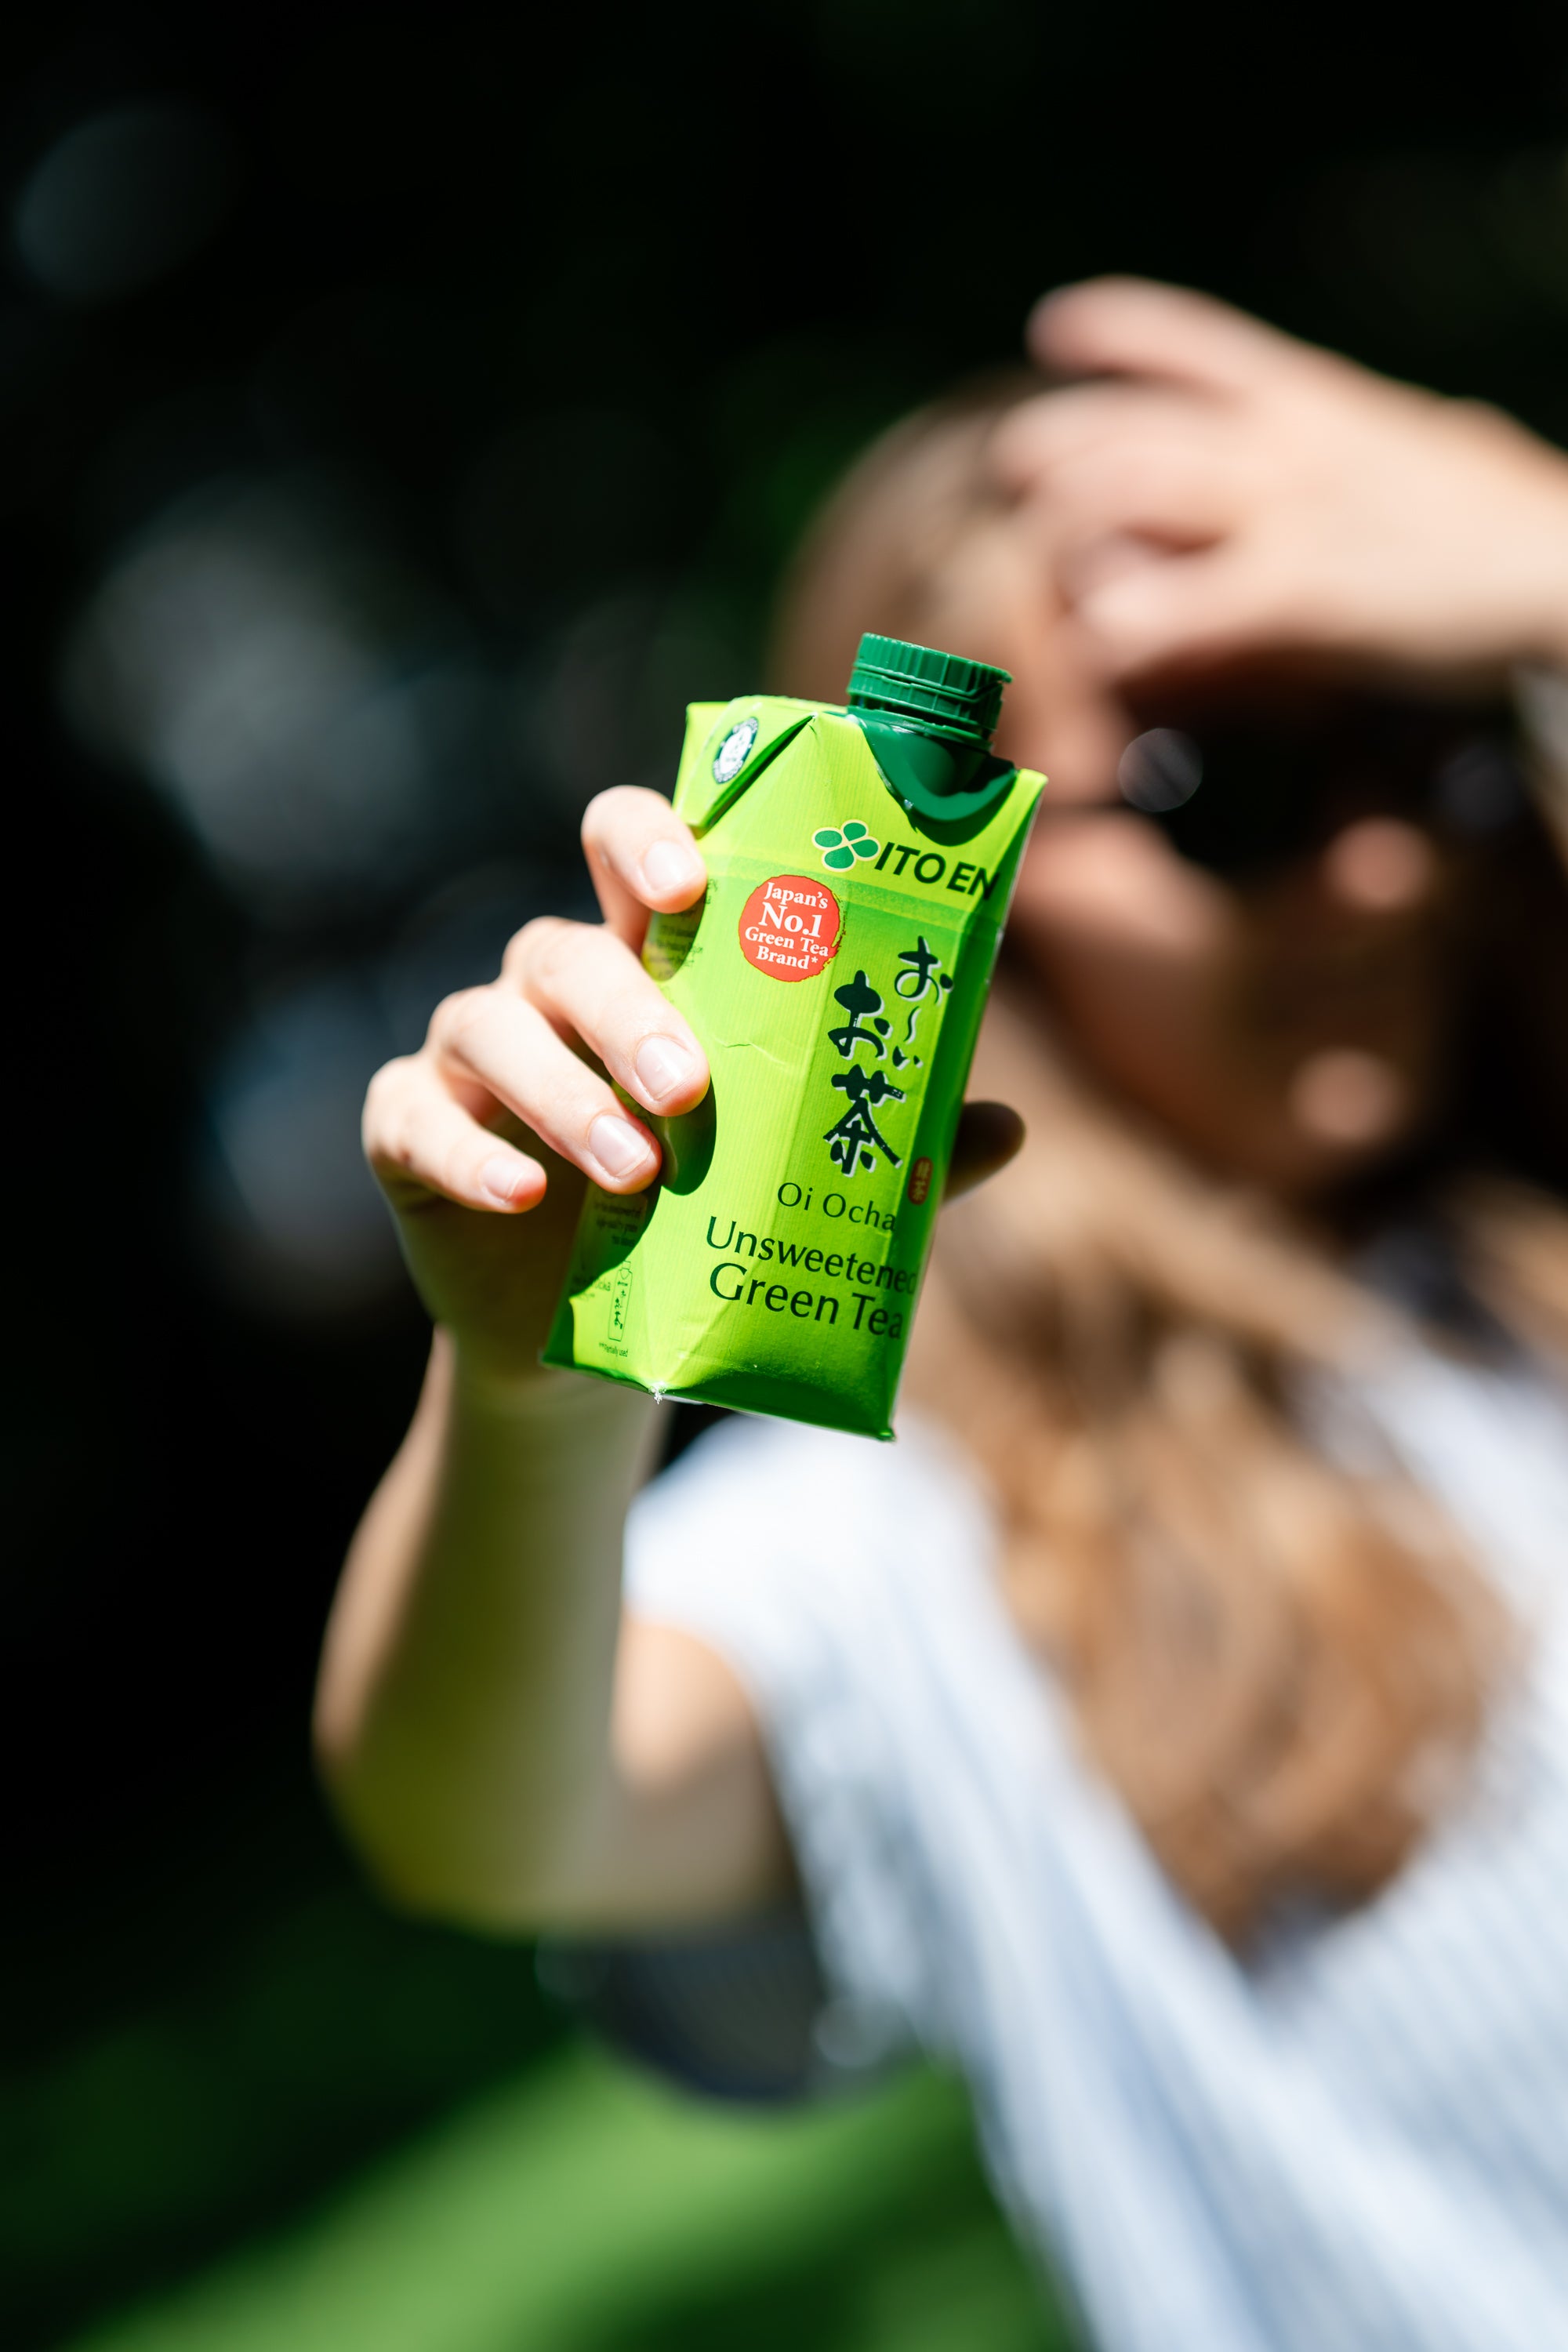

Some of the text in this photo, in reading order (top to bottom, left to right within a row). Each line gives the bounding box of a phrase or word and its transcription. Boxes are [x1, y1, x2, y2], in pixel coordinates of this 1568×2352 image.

[874, 841, 1001, 901] ITO EN
[764, 881, 829, 909] Japan's
[745, 926, 829, 957] Green Tea
[758, 902, 822, 938] No.1
[777, 1181, 897, 1232] Oi Ocha
[710, 1261, 904, 1340] Green Tea
